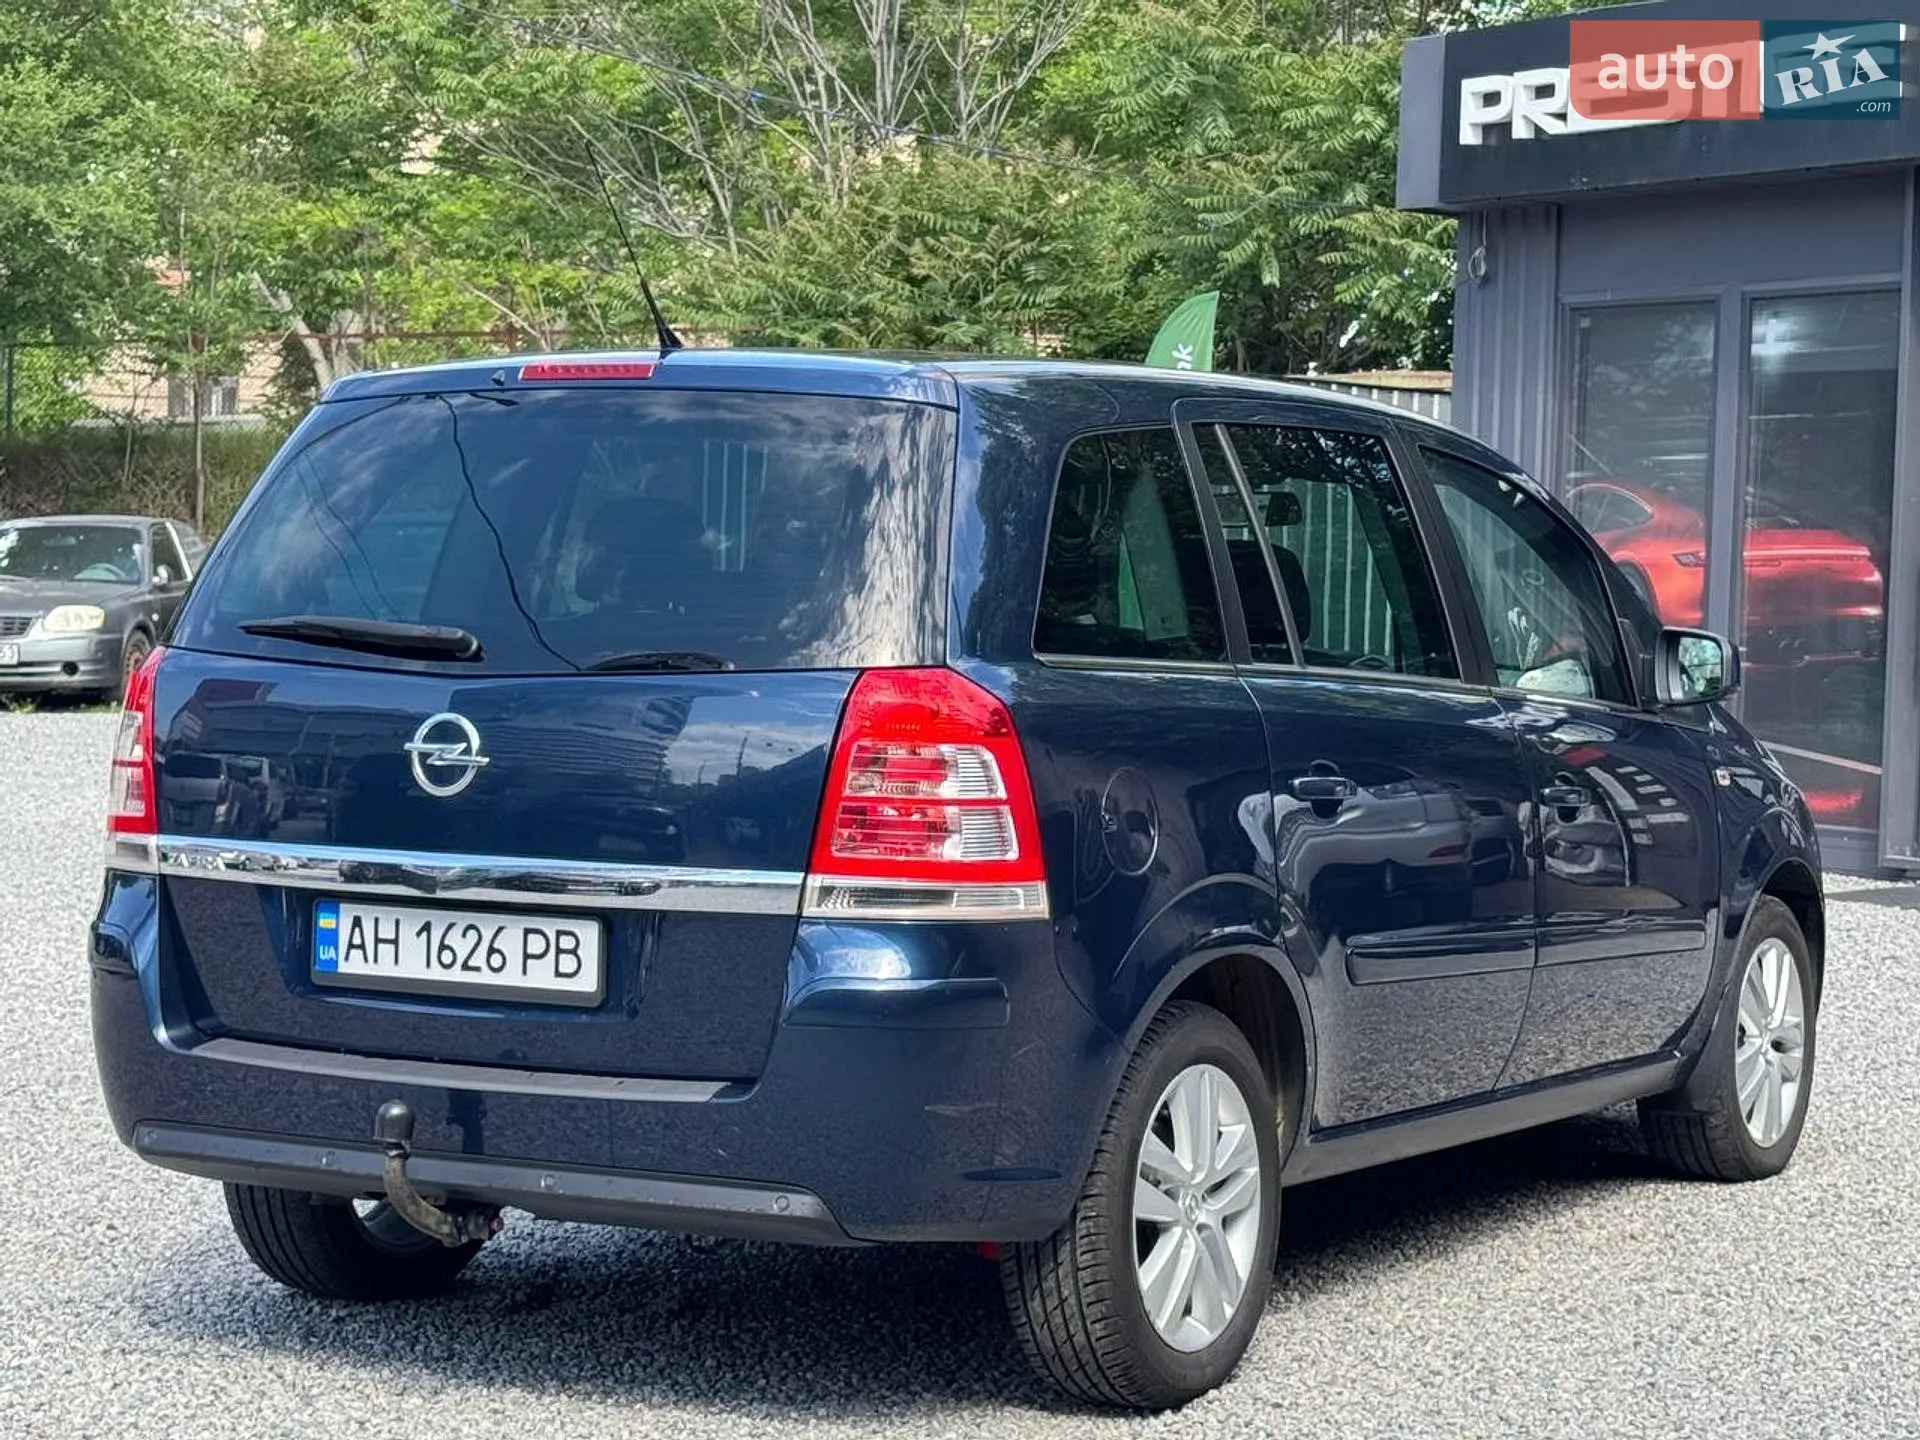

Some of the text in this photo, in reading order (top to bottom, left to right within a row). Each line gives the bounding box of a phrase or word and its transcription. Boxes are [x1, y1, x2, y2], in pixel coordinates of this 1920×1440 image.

[319, 945, 337, 961] UA
[344, 915, 582, 979] AH 1626 PB
